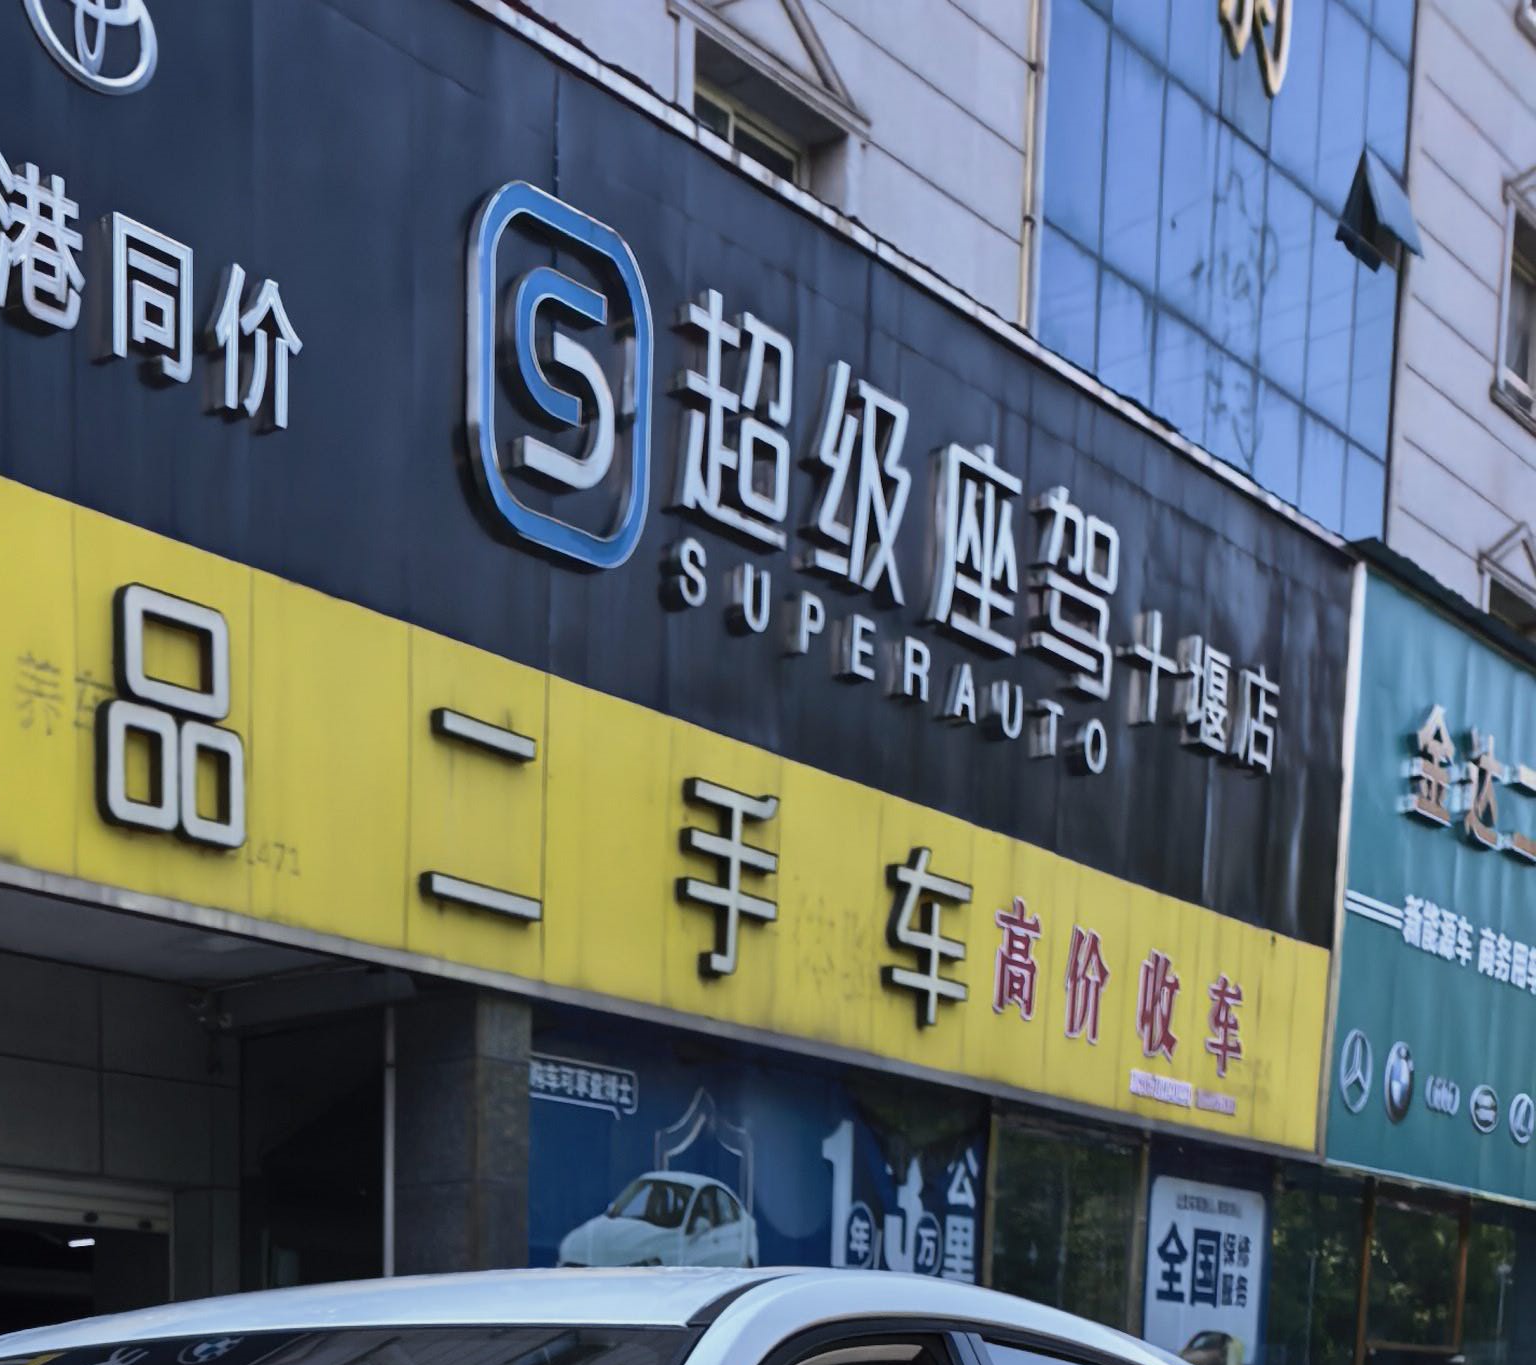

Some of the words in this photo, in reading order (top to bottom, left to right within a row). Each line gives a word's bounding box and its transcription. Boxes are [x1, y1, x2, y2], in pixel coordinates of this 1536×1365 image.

[675, 288, 1120, 702] 超级座驾
[1120, 610, 1280, 774] 十堰店
[674, 537, 1109, 775] SUPERAUTO
[992, 896, 1244, 1078] 高价收车
[1155, 1219, 1222, 1309] 全国
